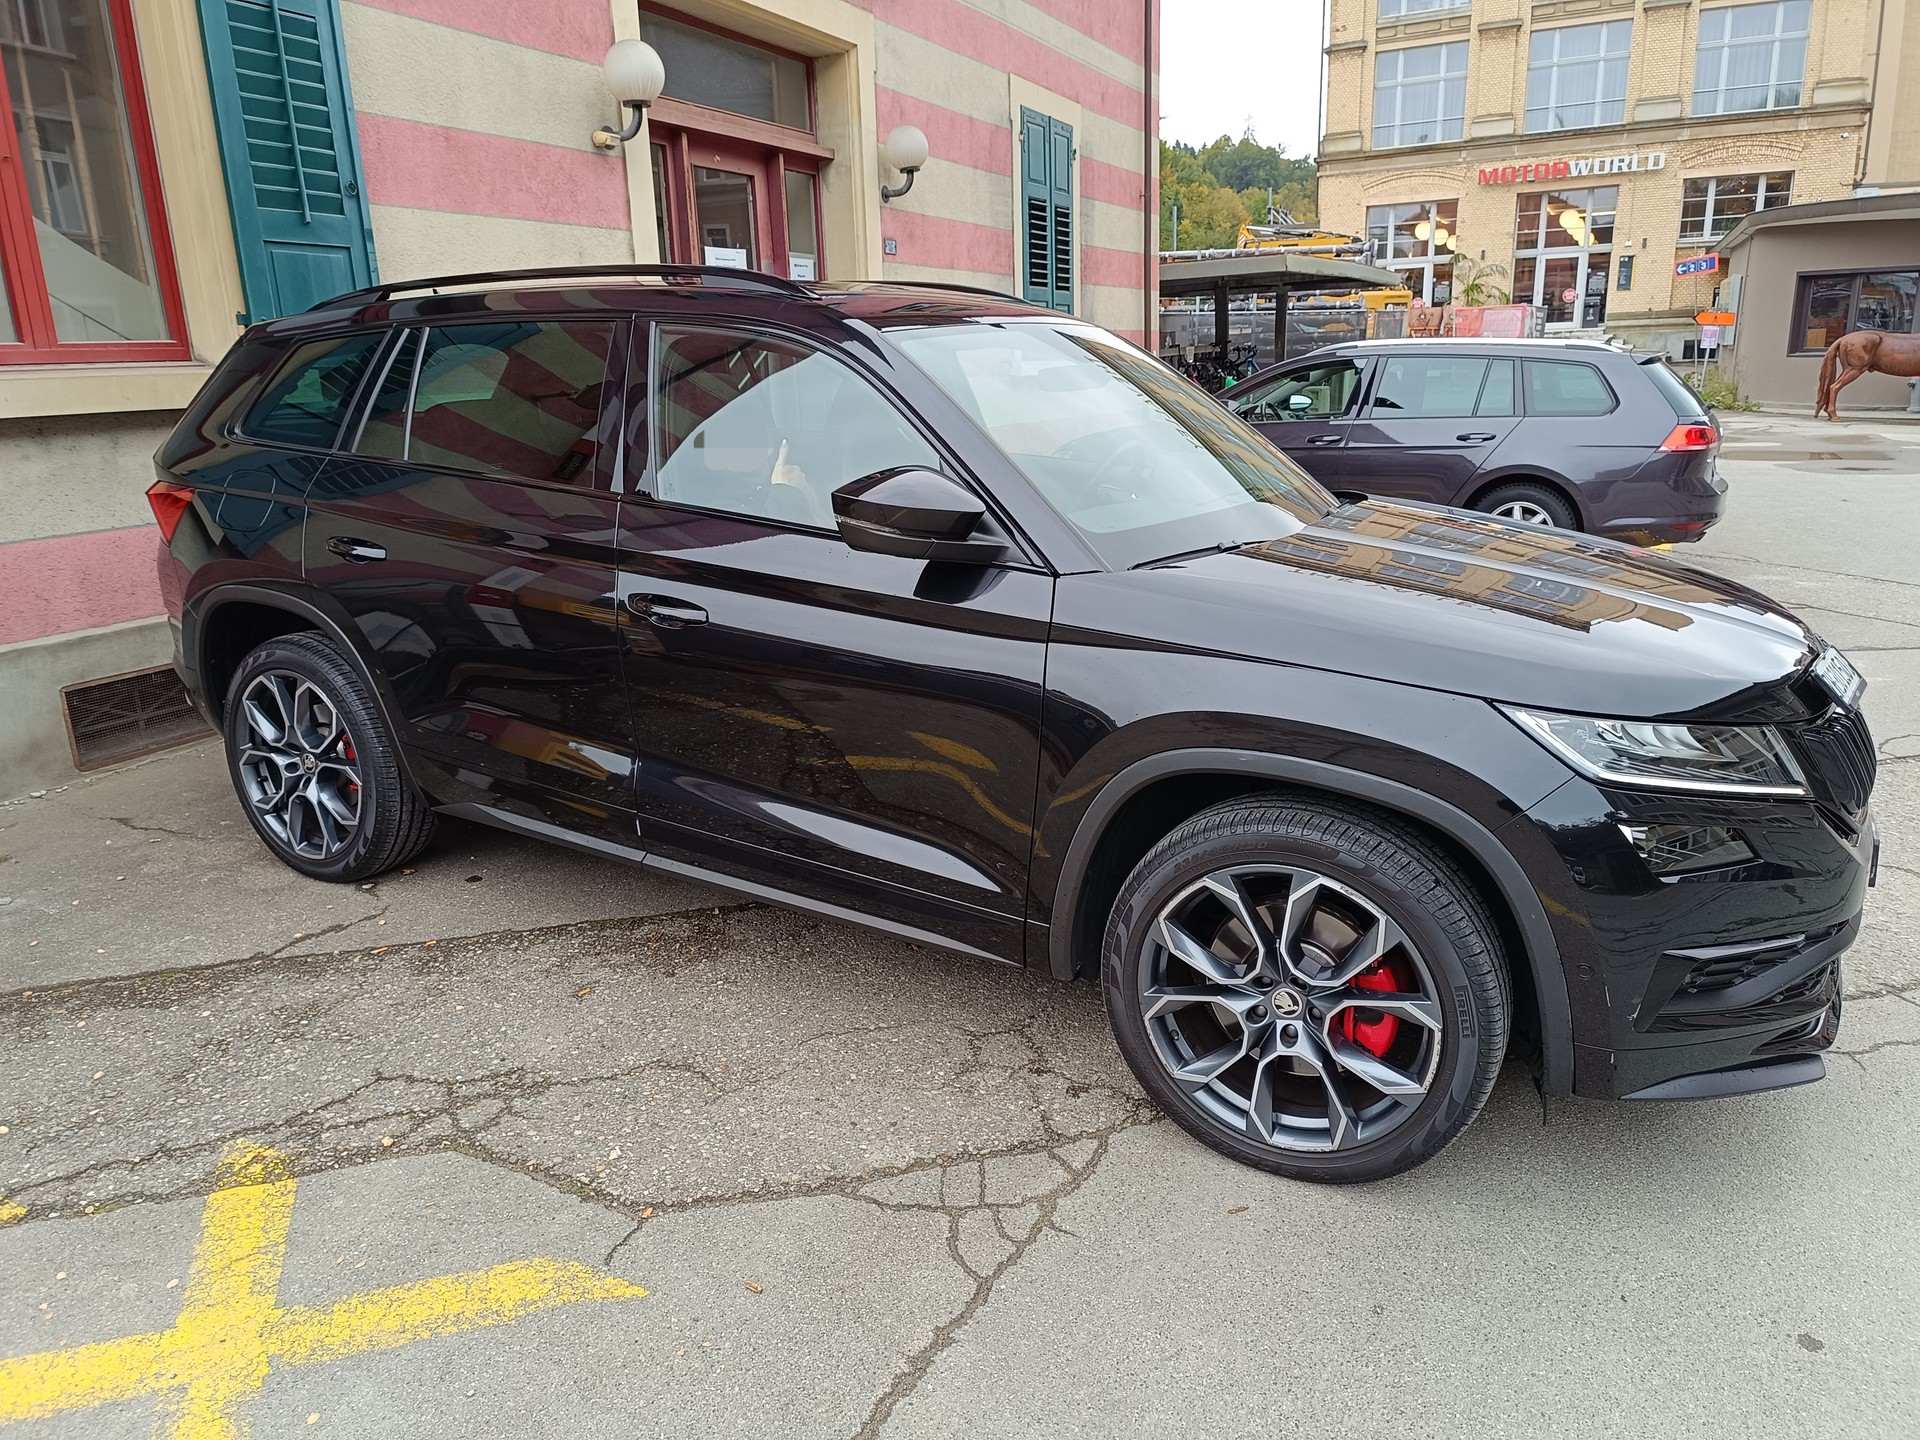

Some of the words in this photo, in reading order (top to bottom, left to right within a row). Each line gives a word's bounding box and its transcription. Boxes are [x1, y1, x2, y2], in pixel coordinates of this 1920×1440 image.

[1478, 152, 1666, 185] MOTORWORLD
[1689, 264, 1695, 272] 2
[1700, 262, 1706, 270] 3
[1454, 984, 1476, 1039] PIRELLI
